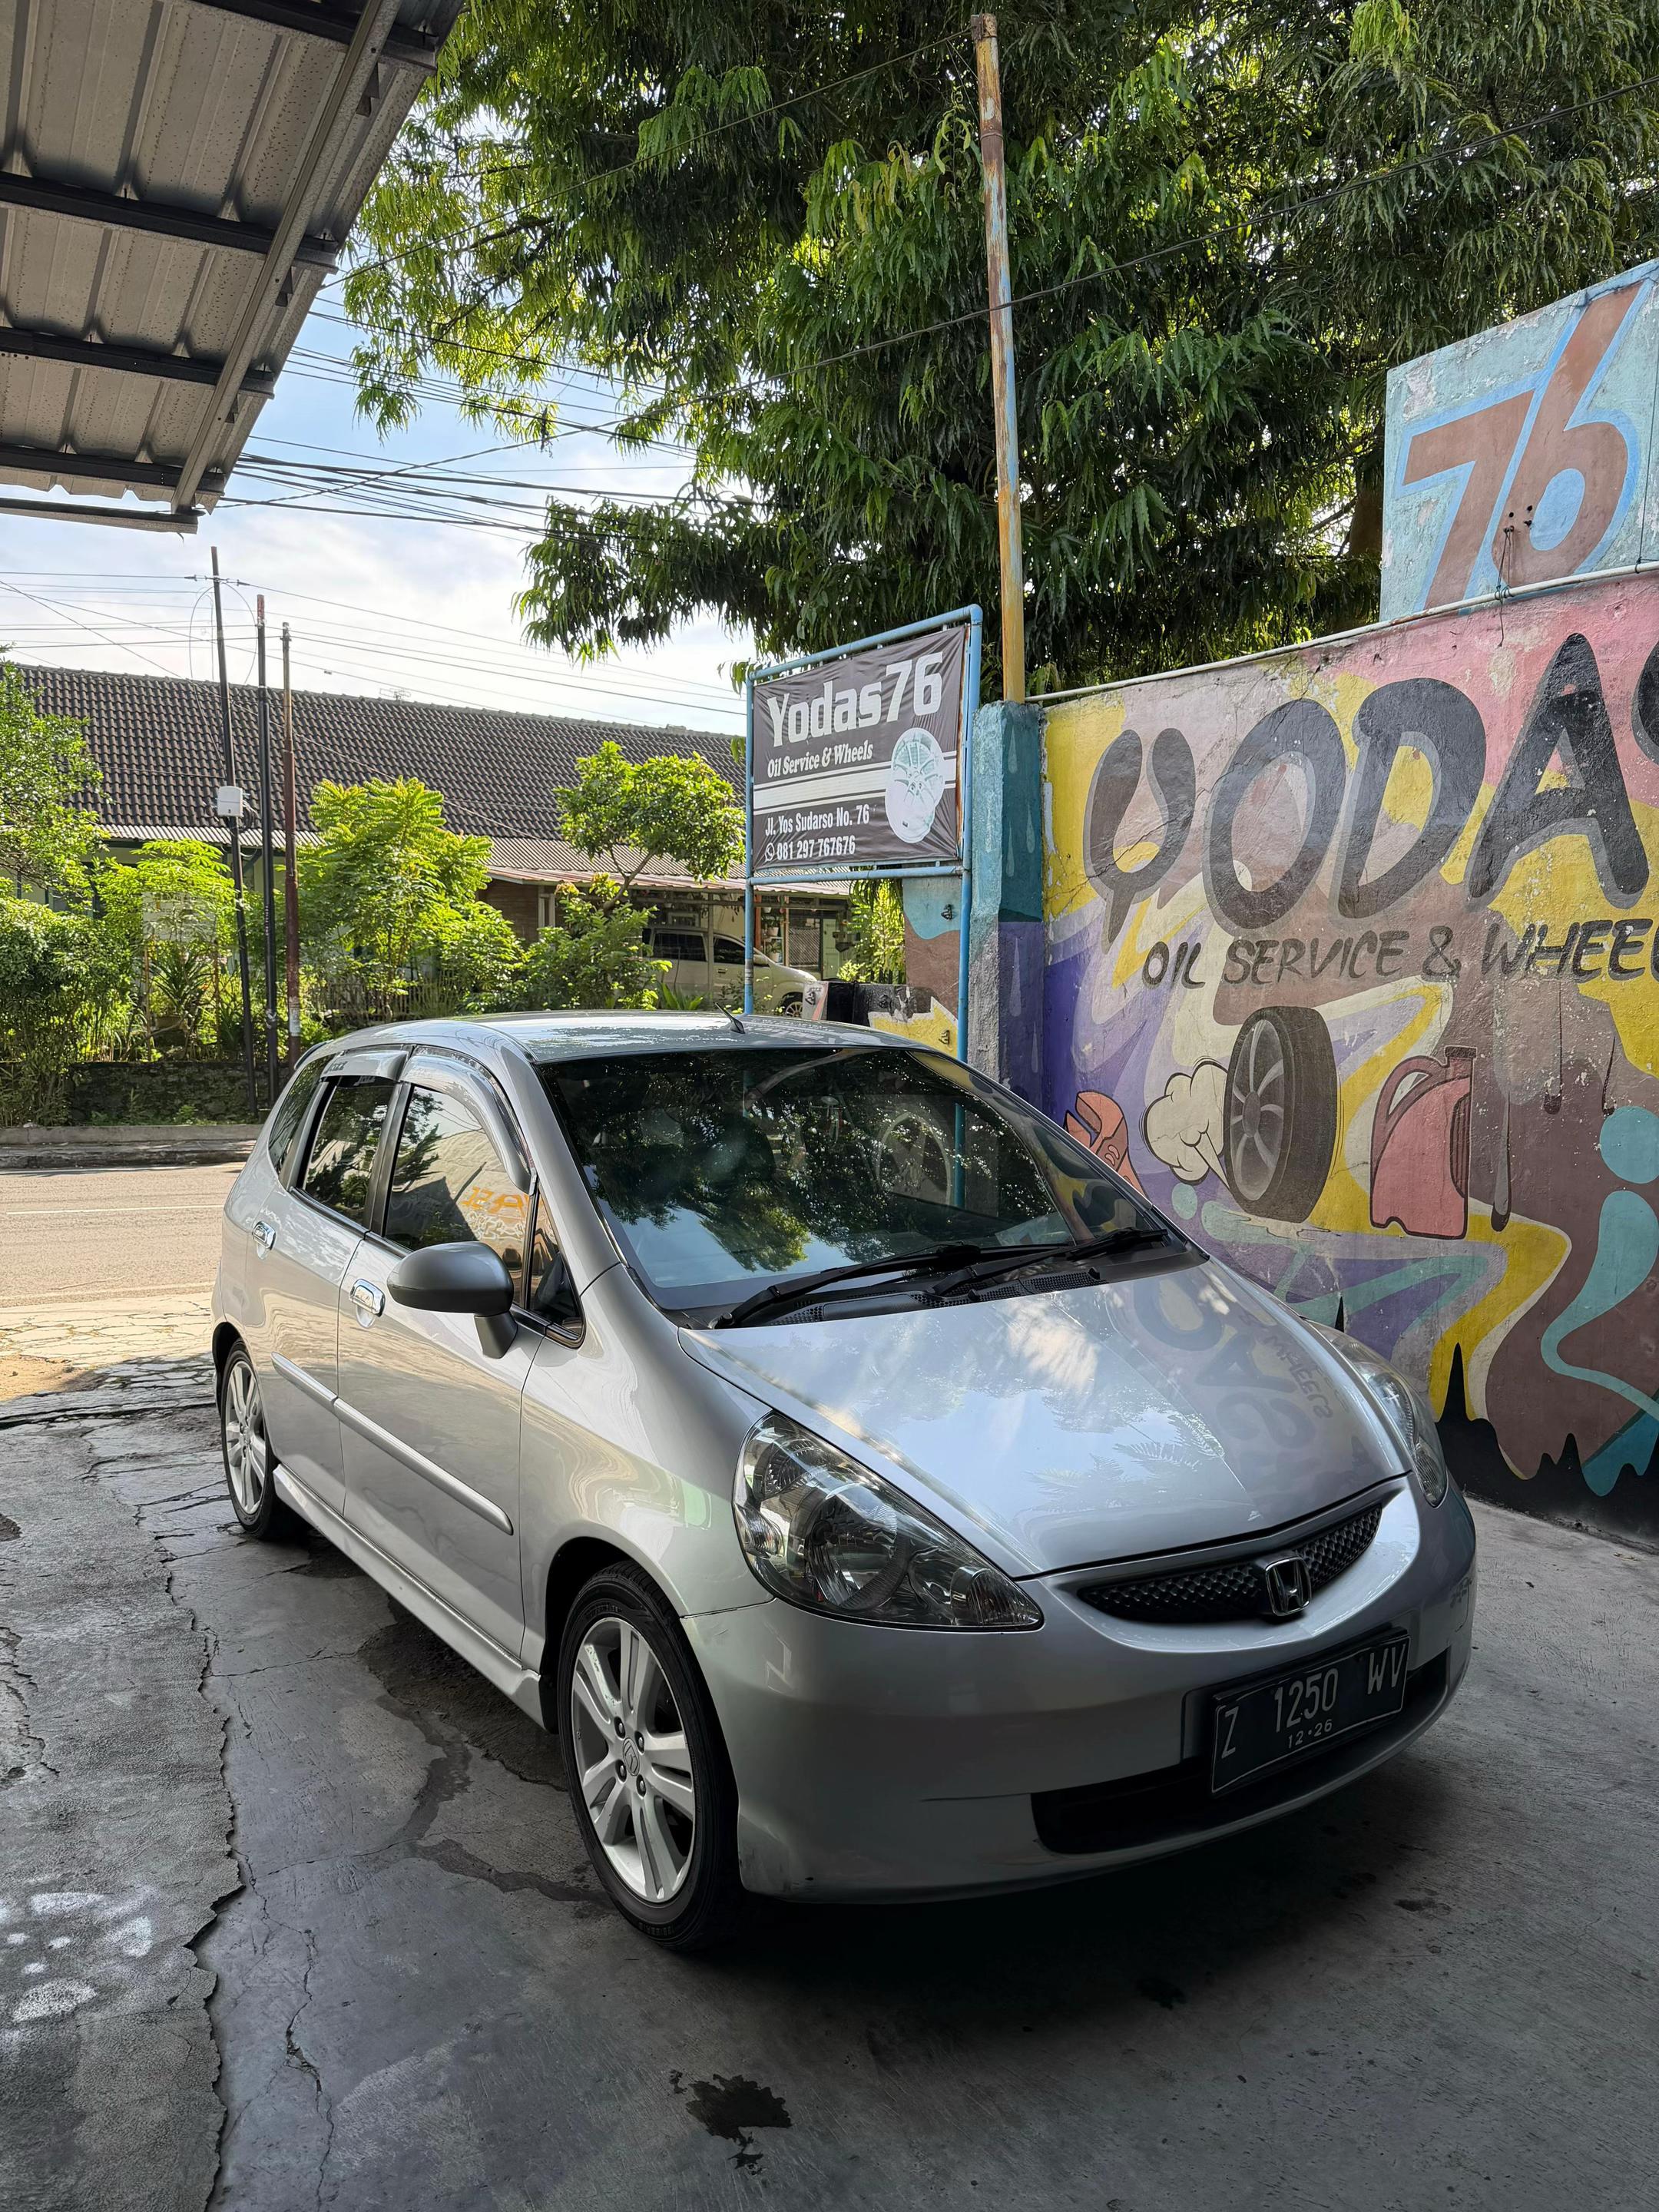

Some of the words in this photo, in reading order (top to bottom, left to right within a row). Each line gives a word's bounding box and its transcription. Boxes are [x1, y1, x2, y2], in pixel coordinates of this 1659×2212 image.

[1396, 280, 1644, 613] 76
[767, 651, 943, 747] Yodas76
[767, 757, 782, 778] Oil
[783, 752, 820, 777] Service
[821, 747, 832, 767] &
[833, 740, 873, 765] Wheels
[1082, 632, 1659, 953] YODA
[777, 841, 793, 861] 081
[796, 839, 815, 859] 297
[817, 835, 856, 857] 767676
[778, 815, 793, 834] Yos
[795, 811, 833, 833] Sudarso
[836, 806, 853, 827] No.
[856, 803, 870, 825] 76
[1141, 940, 1206, 989] OIL
[1222, 929, 1410, 985] SERVICE
[1421, 925, 1462, 983] &
[1480, 918, 1659, 984] WHEE
[1220, 1705, 1240, 1760] Z
[1273, 1667, 1339, 1734] 1250
[1366, 1642, 1406, 1695] WV
